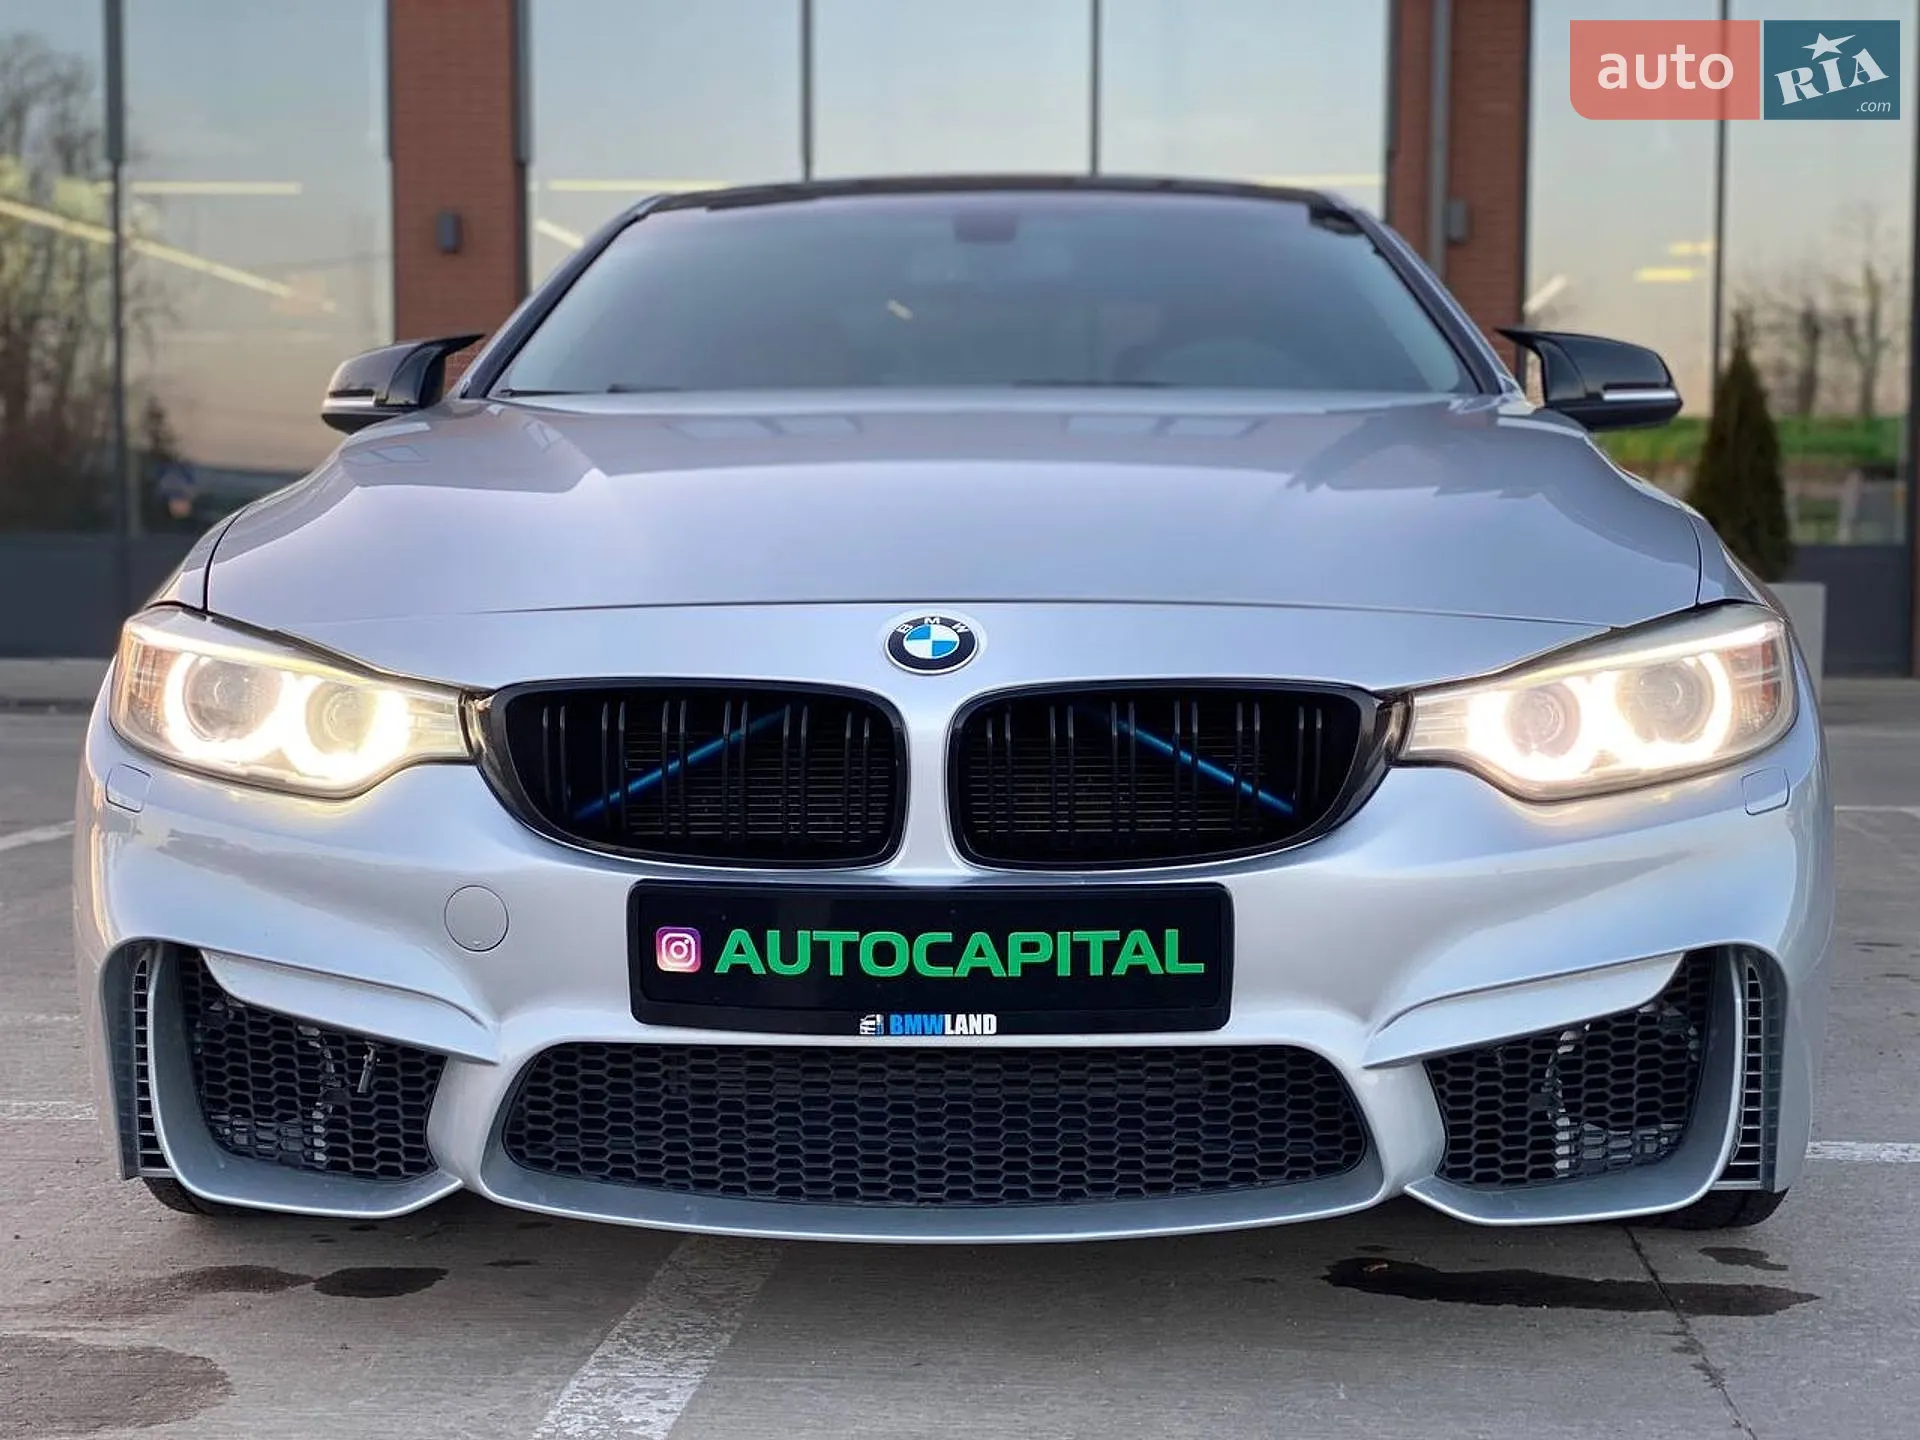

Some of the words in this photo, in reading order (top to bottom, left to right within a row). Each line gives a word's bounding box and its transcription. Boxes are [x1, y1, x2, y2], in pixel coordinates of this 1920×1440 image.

[896, 617, 969, 633] BMW
[714, 929, 1205, 978] AUTOCAPITAL
[889, 1014, 997, 1035] BMWLAND
